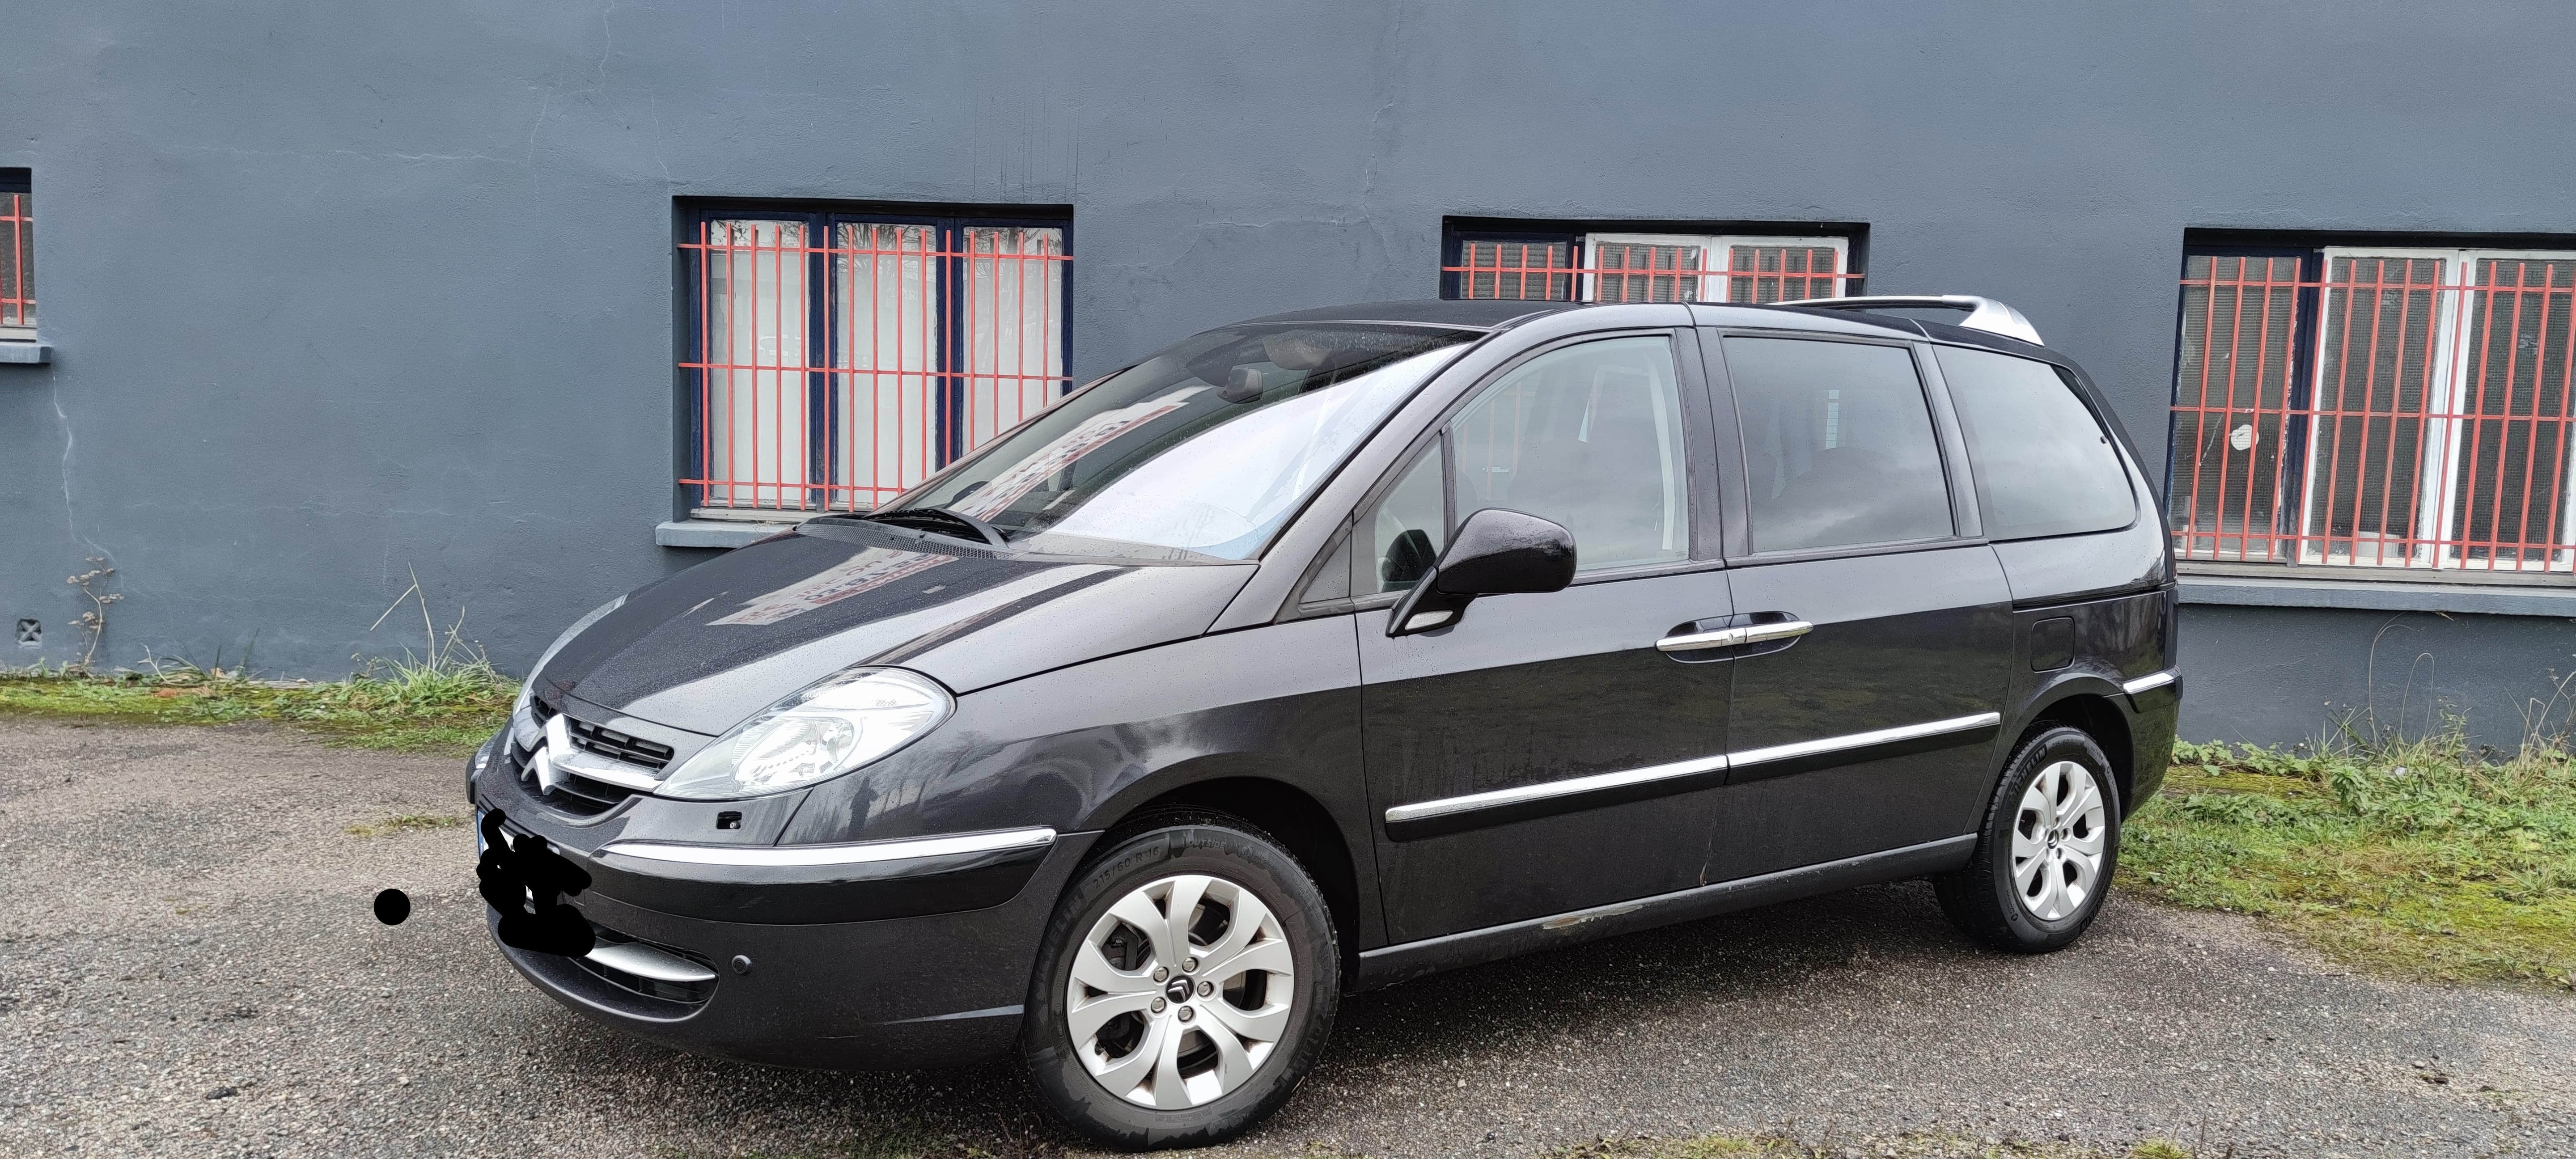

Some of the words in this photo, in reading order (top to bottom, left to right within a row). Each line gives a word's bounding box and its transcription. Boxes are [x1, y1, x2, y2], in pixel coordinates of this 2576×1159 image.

[1188, 838, 1226, 850] OUTSIDE
[1093, 857, 1131, 890] 215/60
[1135, 852, 1144, 863] R
[1147, 846, 1160, 858] 16
